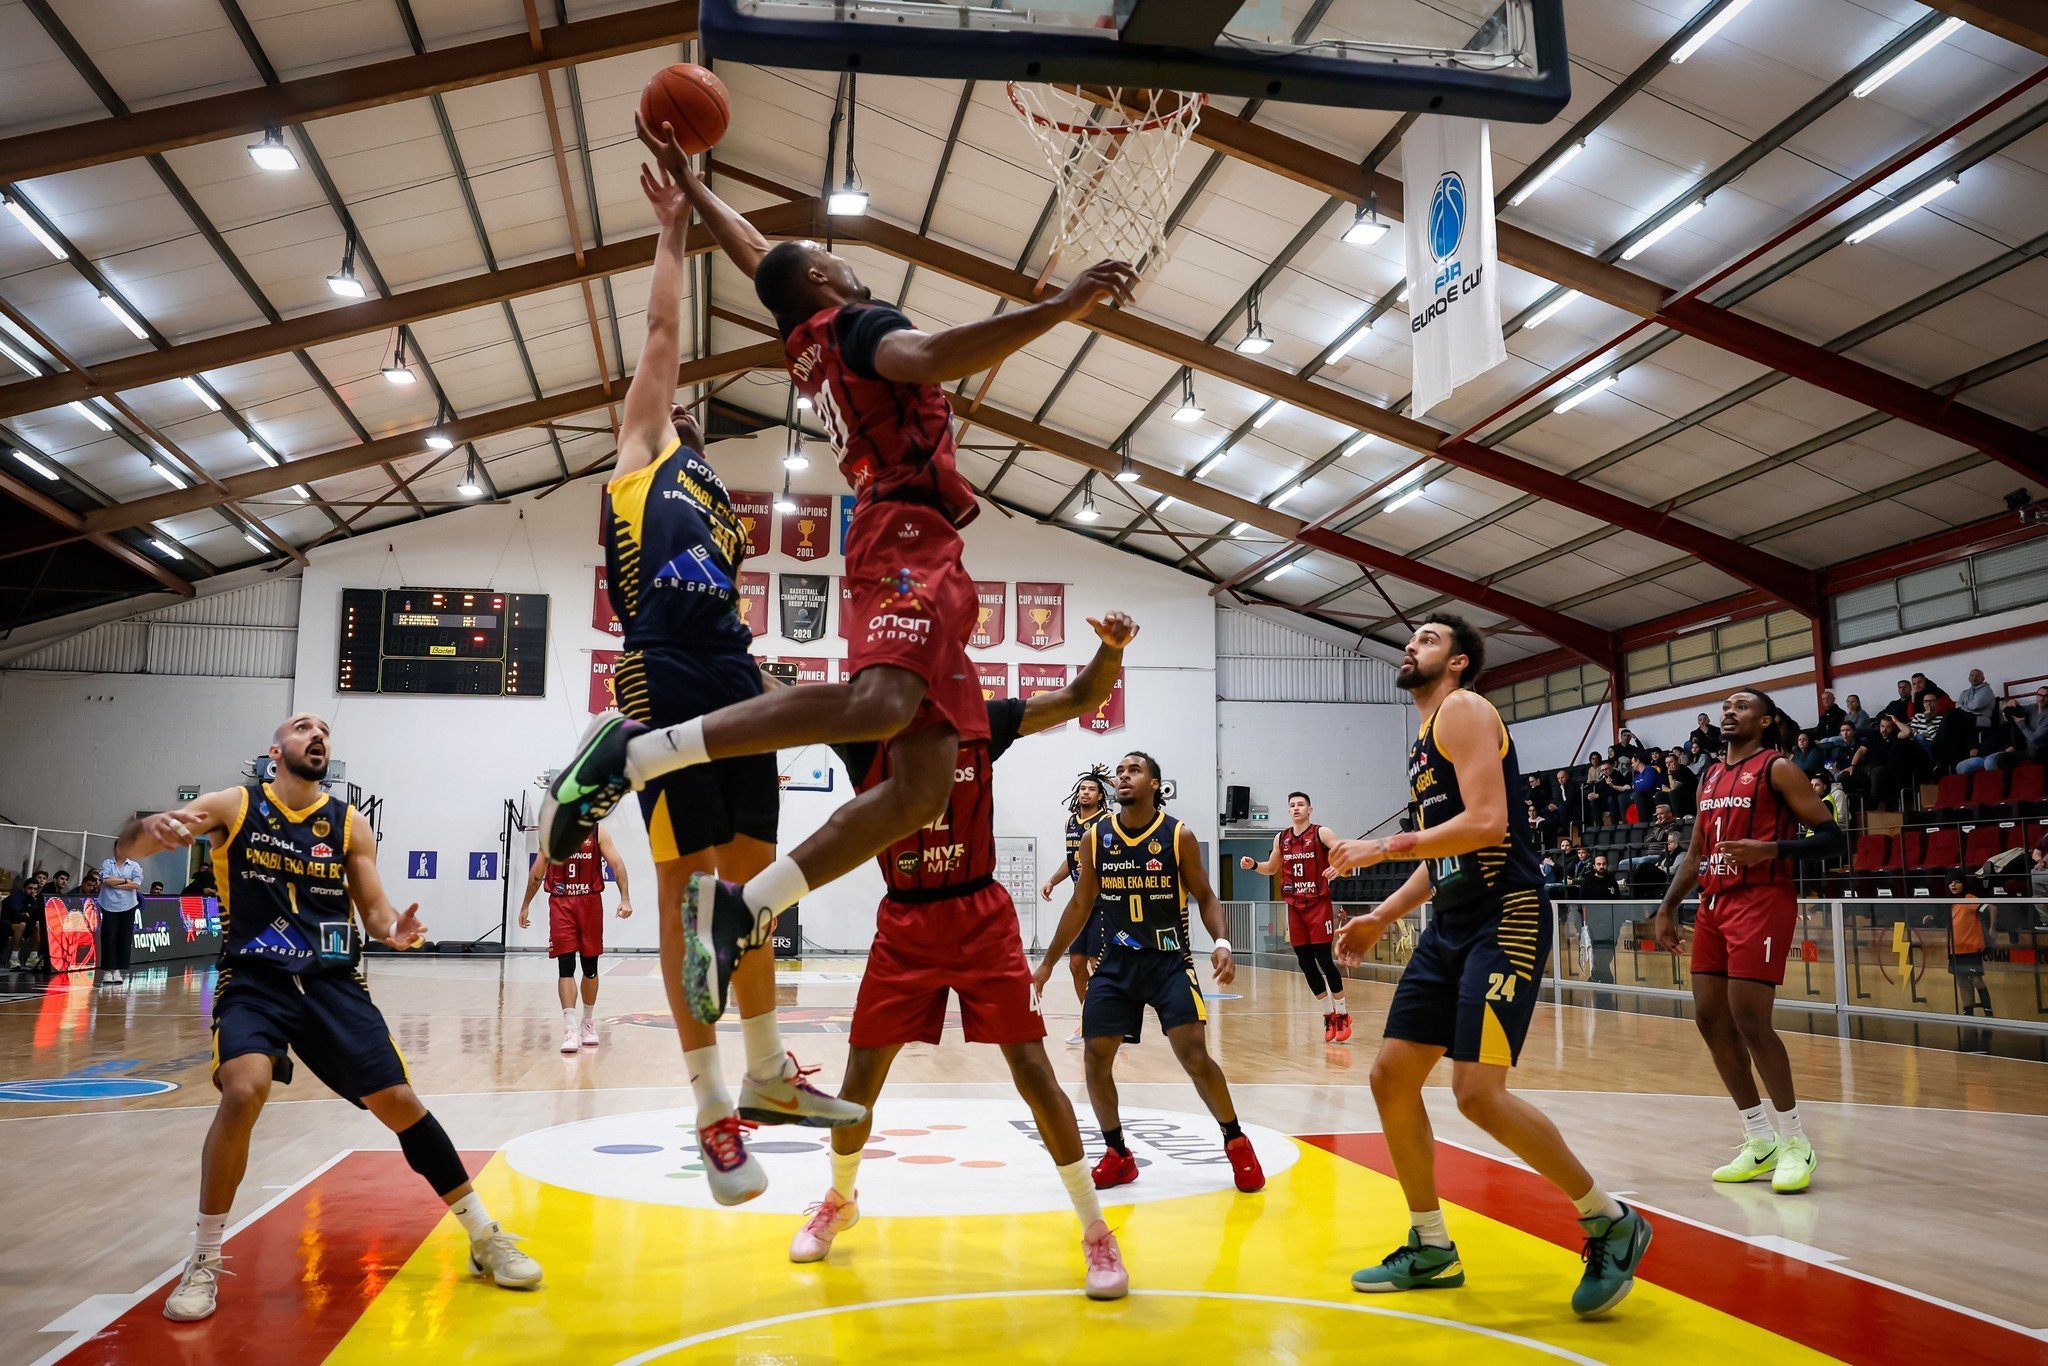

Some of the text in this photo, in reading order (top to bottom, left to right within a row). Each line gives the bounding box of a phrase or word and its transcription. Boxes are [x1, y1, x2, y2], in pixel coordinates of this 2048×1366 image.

[1434, 261, 1462, 295] FBA
[1411, 284, 1459, 333] EUROE
[686, 458, 731, 503] paya
[732, 503, 769, 515] HAMPIONS
[787, 506, 828, 518] AMPIONS
[745, 545, 755, 555] 00
[796, 547, 815, 558] 2001
[740, 584, 766, 596] PIONS
[789, 587, 818, 596] BASKETBALL
[780, 593, 809, 602] CHAMPIONS
[1018, 594, 1062, 606] CUP WINNER
[788, 600, 804, 608] GROUP
[608, 622, 623, 632] 200
[793, 628, 812, 639] 2020
[431, 647, 455, 655] Bodet
[593, 663, 608, 674] CUP
[840, 671, 851, 682] CU
[1020, 676, 1065, 687] CUP WINNER
[1091, 719, 1110, 730] 2024
[1714, 816, 1722, 842] 1
[569, 852, 593, 860] VNOS
[923, 842, 965, 863] NIVE
[1283, 851, 1315, 861] RAVNOS
[283, 856, 304, 875] EKA
[306, 860, 326, 878] AEL
[568, 863, 576, 878] 9
[1292, 863, 1304, 877] 13
[1101, 875, 1172, 889] PAYABL EKA AEL BC
[310, 886, 343, 896] aramex
[1128, 894, 1144, 923] 0
[1763, 936, 1772, 963] 1
[1485, 971, 1518, 1003] 24
